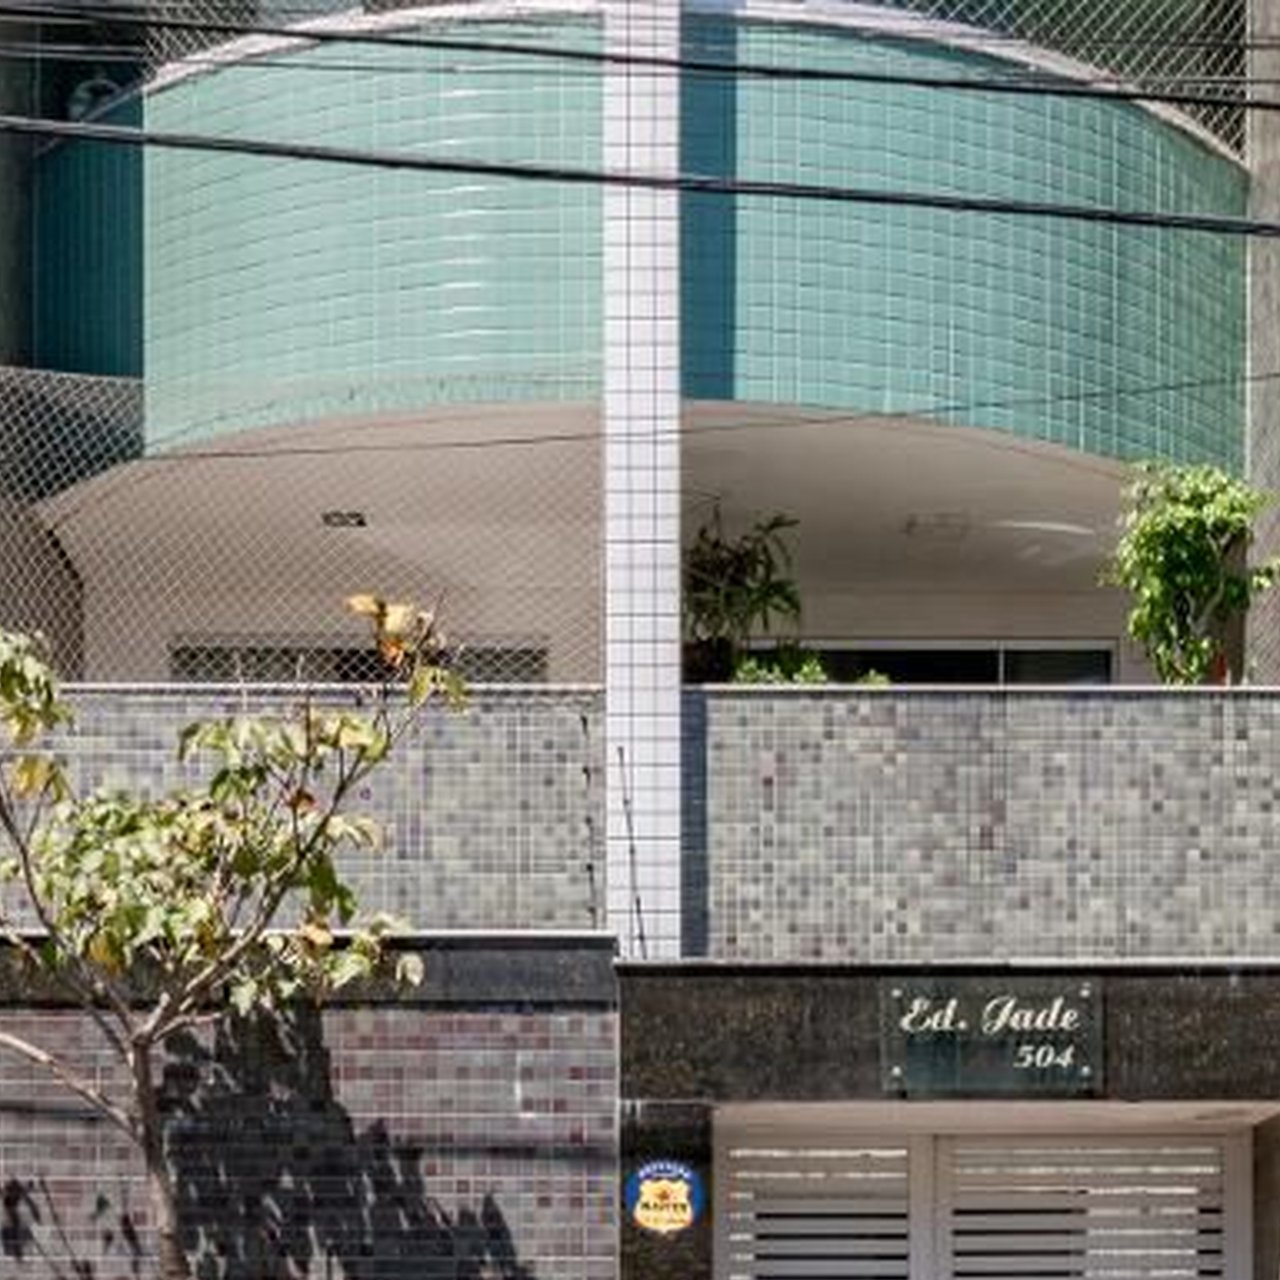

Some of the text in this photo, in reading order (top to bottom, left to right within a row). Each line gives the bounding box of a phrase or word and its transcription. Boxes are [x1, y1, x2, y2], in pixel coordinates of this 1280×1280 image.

[900, 996, 1080, 1034] Ed. Jade
[1013, 1044, 1075, 1069] 504
